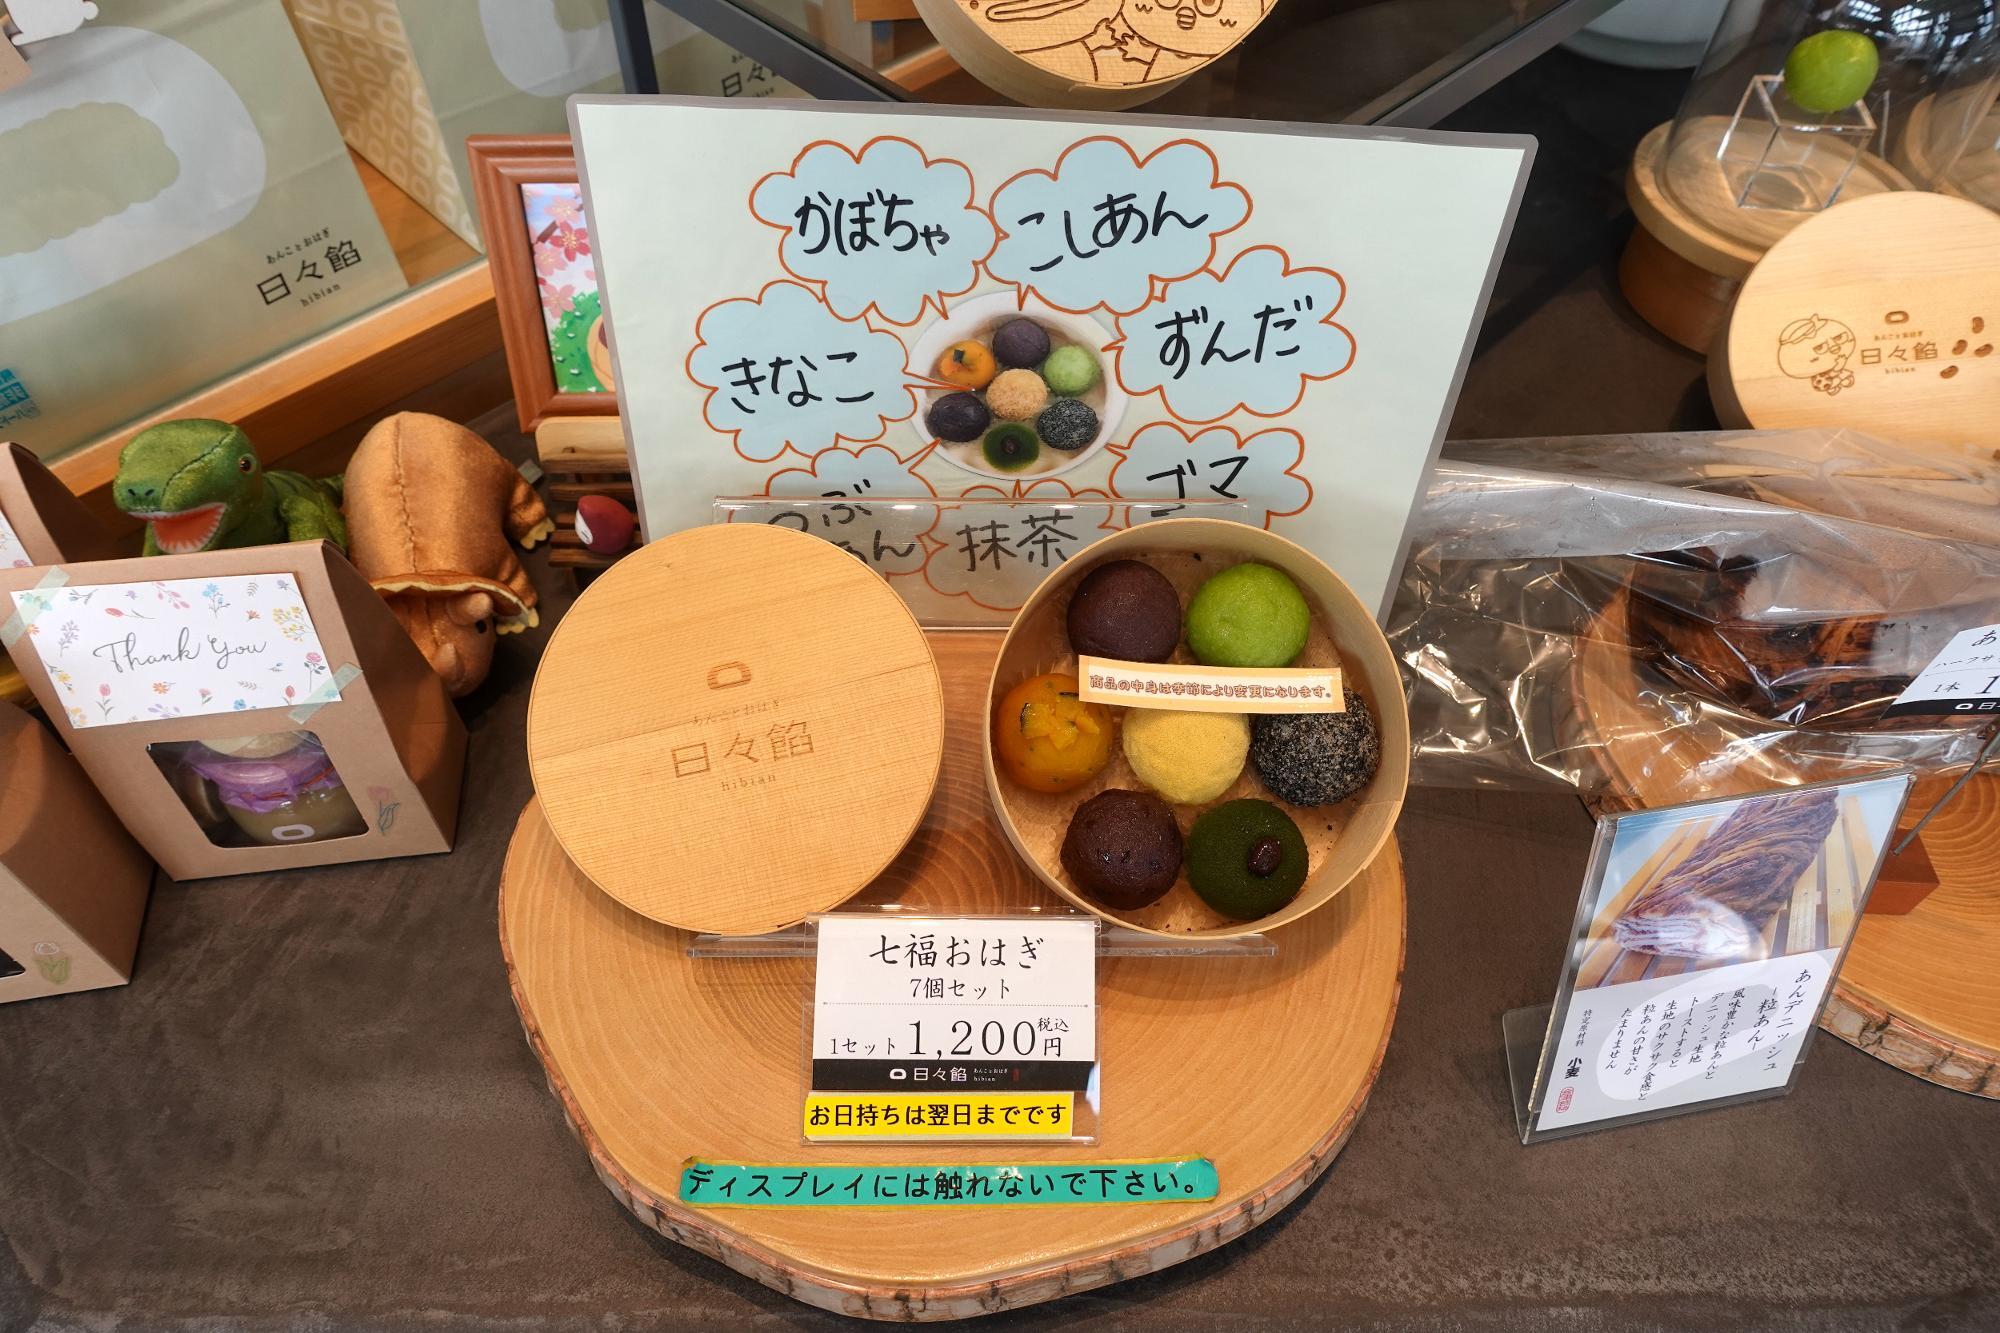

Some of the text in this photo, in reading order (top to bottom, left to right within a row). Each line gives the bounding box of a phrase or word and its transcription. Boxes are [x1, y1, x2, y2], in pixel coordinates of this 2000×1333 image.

[793, 190, 951, 256] かぼちゃ
[1017, 190, 1209, 271] こしあん
[256, 239, 362, 305] 日々餡
[301, 283, 341, 307] hibian
[1154, 295, 1314, 380] ずんだ
[1860, 341, 1938, 365] 日々餡
[721, 351, 875, 414] きなこ
[1145, 456, 1249, 517] ゴマ
[956, 509, 1080, 572] 抹茶
[93, 626, 267, 674] Thank You
[1089, 674, 1333, 699] 商品の中身は季節により変更になります。
[670, 720, 814, 778] 日々餡
[720, 774, 777, 791] hibian
[869, 933, 1045, 970] 七福おはぎ
[909, 976, 1010, 1000] 7個セット
[830, 1019, 1062, 1061] 1セット 1,200 円
[1037, 1016, 1070, 1033] 税込
[1605, 1008, 1632, 1070] たまりません
[1624, 1004, 1656, 1076] 粒あんの甘さが
[1669, 996, 1699, 1068] トーストすると
[1688, 992, 1725, 1065] デニッシュ生地
[1704, 987, 1746, 1080] 風味豊かな粒あんと
[1763, 968, 1812, 1071] あんデニッシュ
[913, 1066, 967, 1082] 日々餡
[1564, 1057, 1583, 1079] 小麦
[1638, 1000, 1677, 1101] 生地のサクサク食感と
[809, 1103, 1067, 1127] お日持ちは翌日までです
[687, 1167, 1195, 1200] ディスプレイには触れないで下さい。
